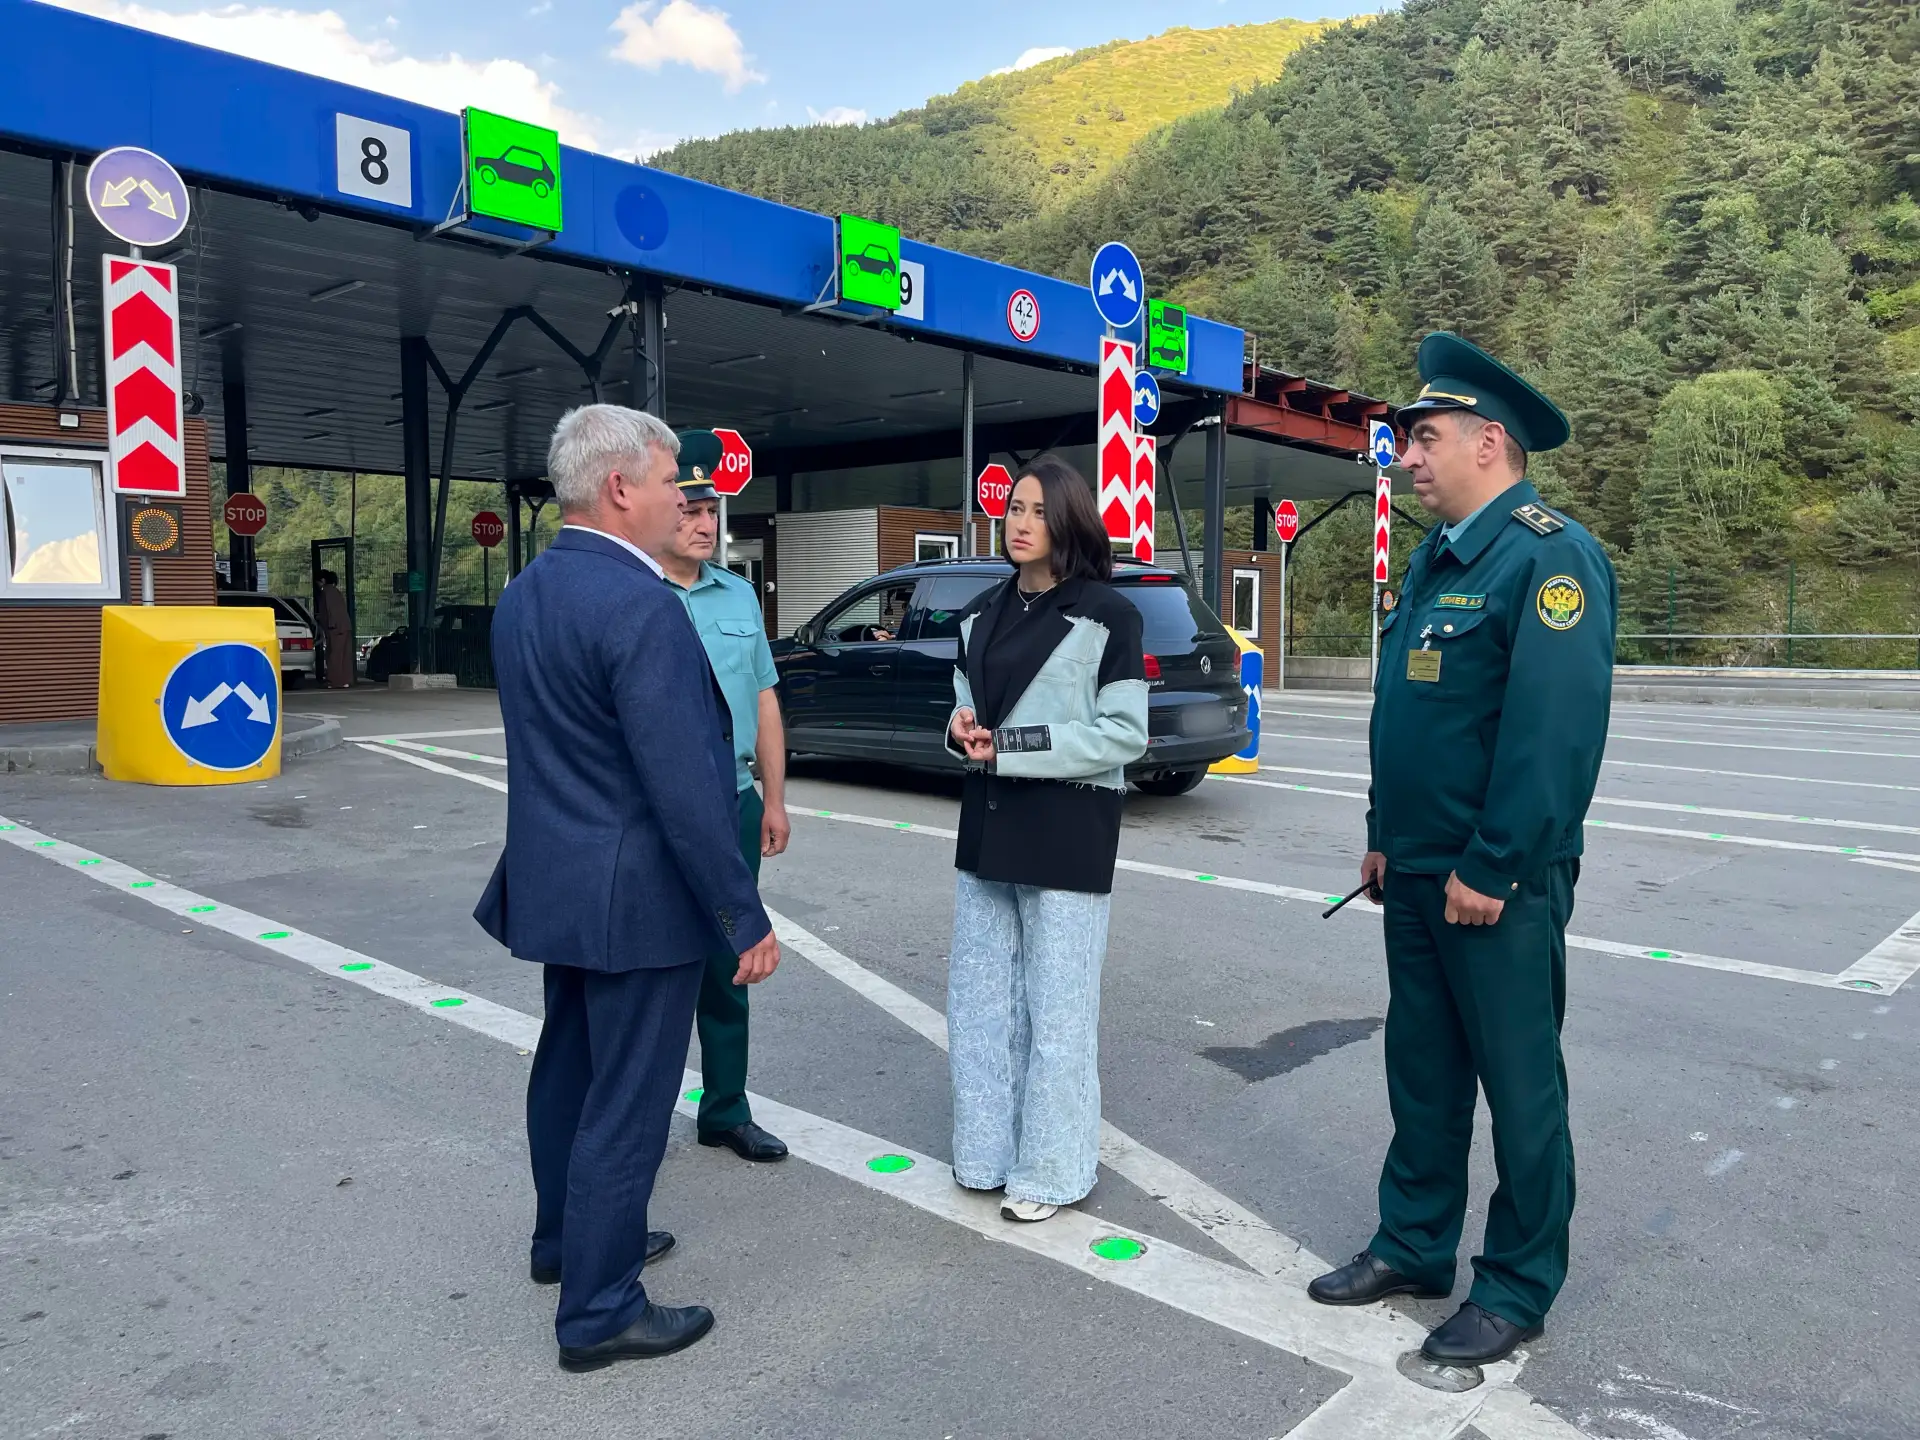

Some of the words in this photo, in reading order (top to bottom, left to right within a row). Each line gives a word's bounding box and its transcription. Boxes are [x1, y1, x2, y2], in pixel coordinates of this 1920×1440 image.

[361, 137, 389, 185] 8
[899, 271, 913, 305] 9
[1015, 300, 1033, 318] 4,2
[719, 452, 749, 473] OP
[980, 481, 1011, 500] STOP
[226, 507, 265, 522] STOP
[1277, 513, 1297, 528] STOP
[473, 522, 503, 536] STOP
